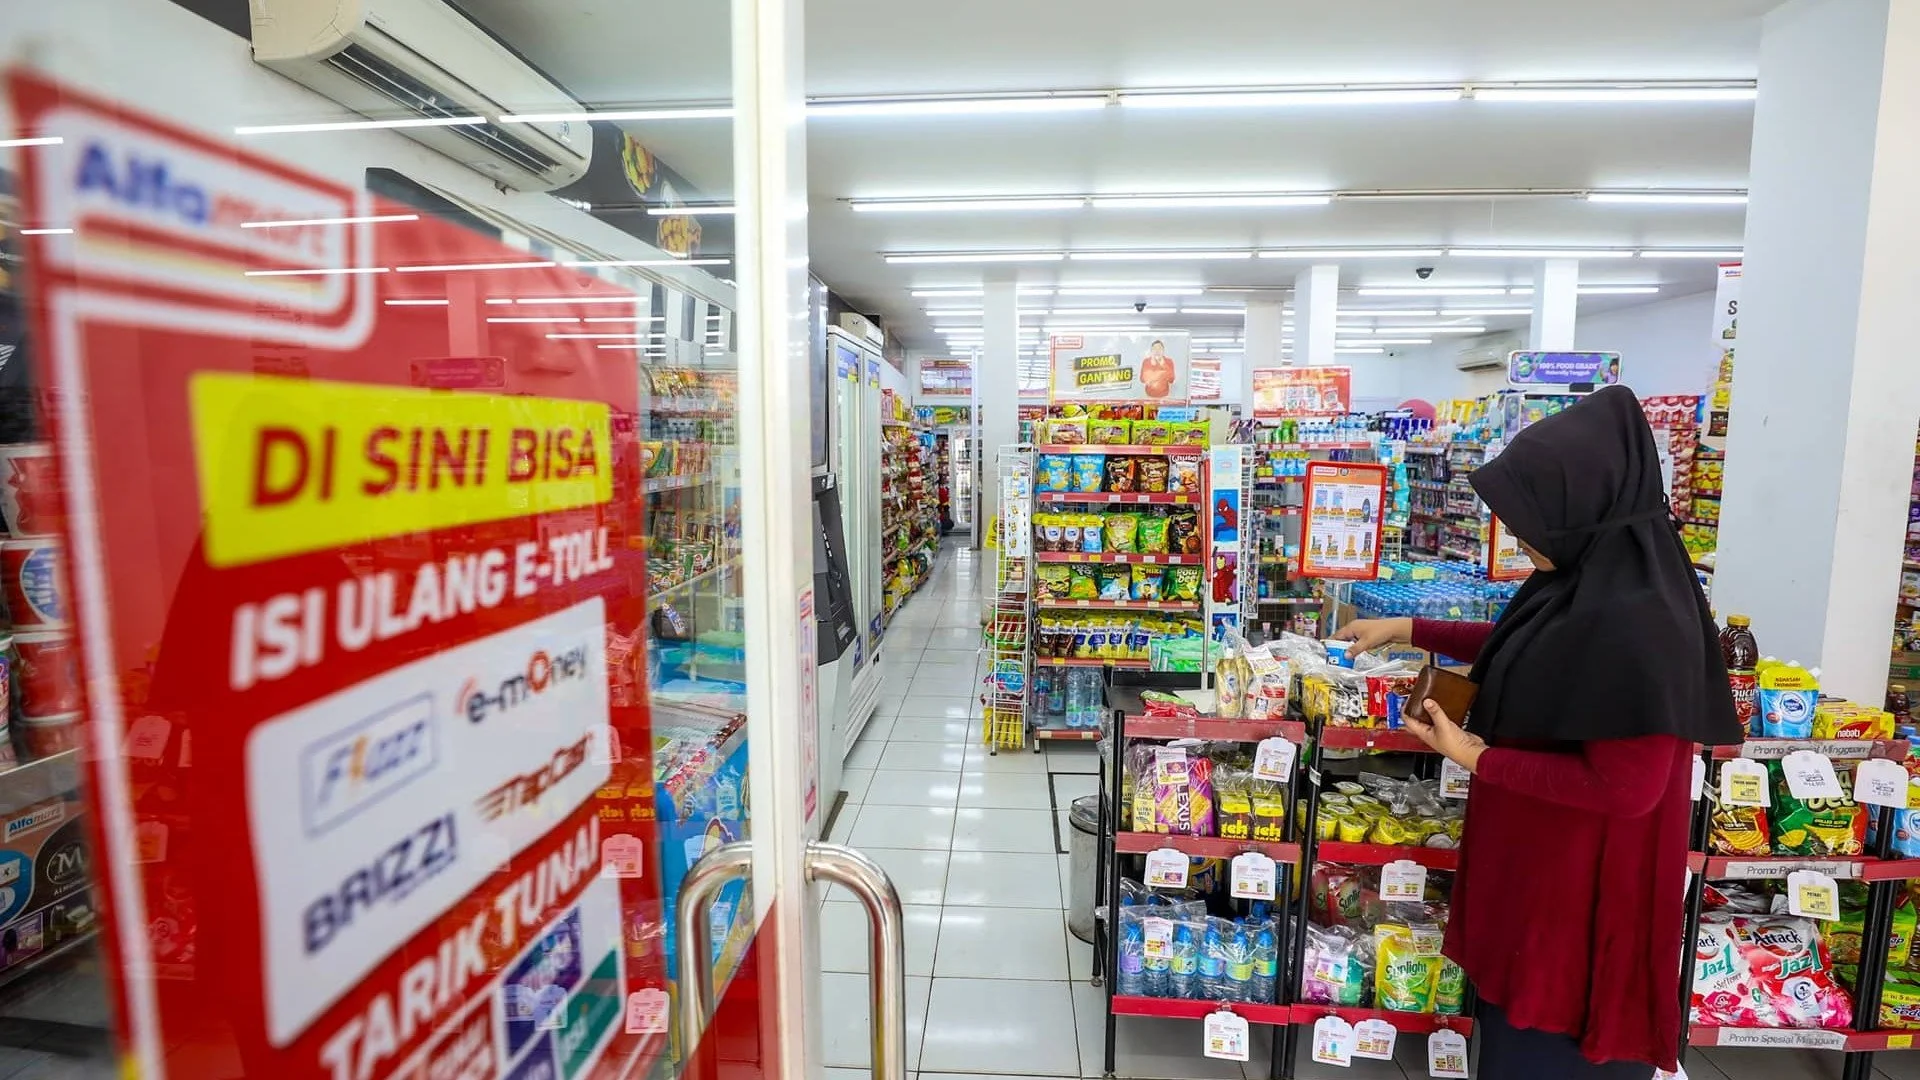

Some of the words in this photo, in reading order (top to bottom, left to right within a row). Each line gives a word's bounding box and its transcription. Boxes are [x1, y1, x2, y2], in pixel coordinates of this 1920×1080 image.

[1080, 355, 1117, 368] PROMO
[1556, 362, 1575, 370] FOOD
[1079, 370, 1131, 385] GANTUNG
[249, 424, 337, 510] DI
[361, 425, 492, 499] SINI
[507, 427, 600, 483] BISA
[228, 586, 327, 691] ISI
[336, 559, 503, 654] ULANG
[513, 528, 616, 598] E-TOLL
[1387, 651, 1424, 661] prima
[1753, 745, 1785, 756] Promo
[1177, 783, 1190, 831] LEXUS
[9, 807, 62, 833] Alfamart
[1747, 866, 1777, 876] Promo
[304, 811, 458, 956] BRIZZI
[318, 903, 489, 1080] TARIK
[494, 812, 600, 947] TUNAI
[1753, 928, 1803, 946] Attack
[1385, 960, 1427, 981] Sunlight
[1728, 1032, 1760, 1043] Promo
[1761, 1033, 1794, 1045] Spesial
